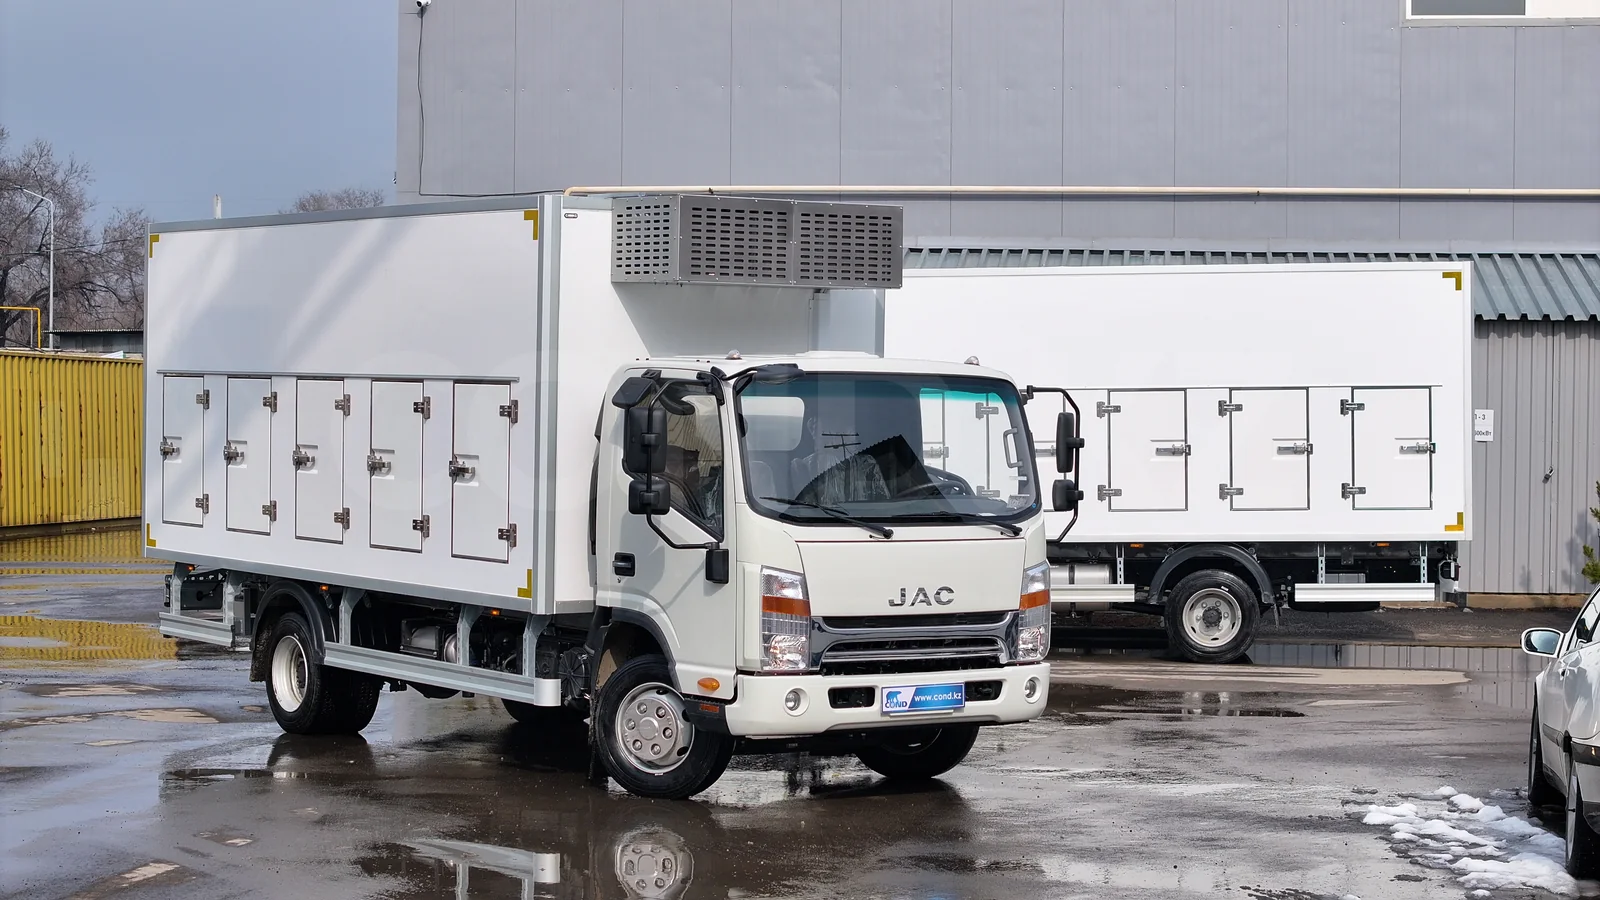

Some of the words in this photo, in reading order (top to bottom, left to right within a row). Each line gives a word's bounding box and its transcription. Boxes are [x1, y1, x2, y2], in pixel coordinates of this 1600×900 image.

[888, 586, 955, 607] JAC
[914, 692, 962, 702] www.cond.kz
[884, 700, 908, 709] COND
